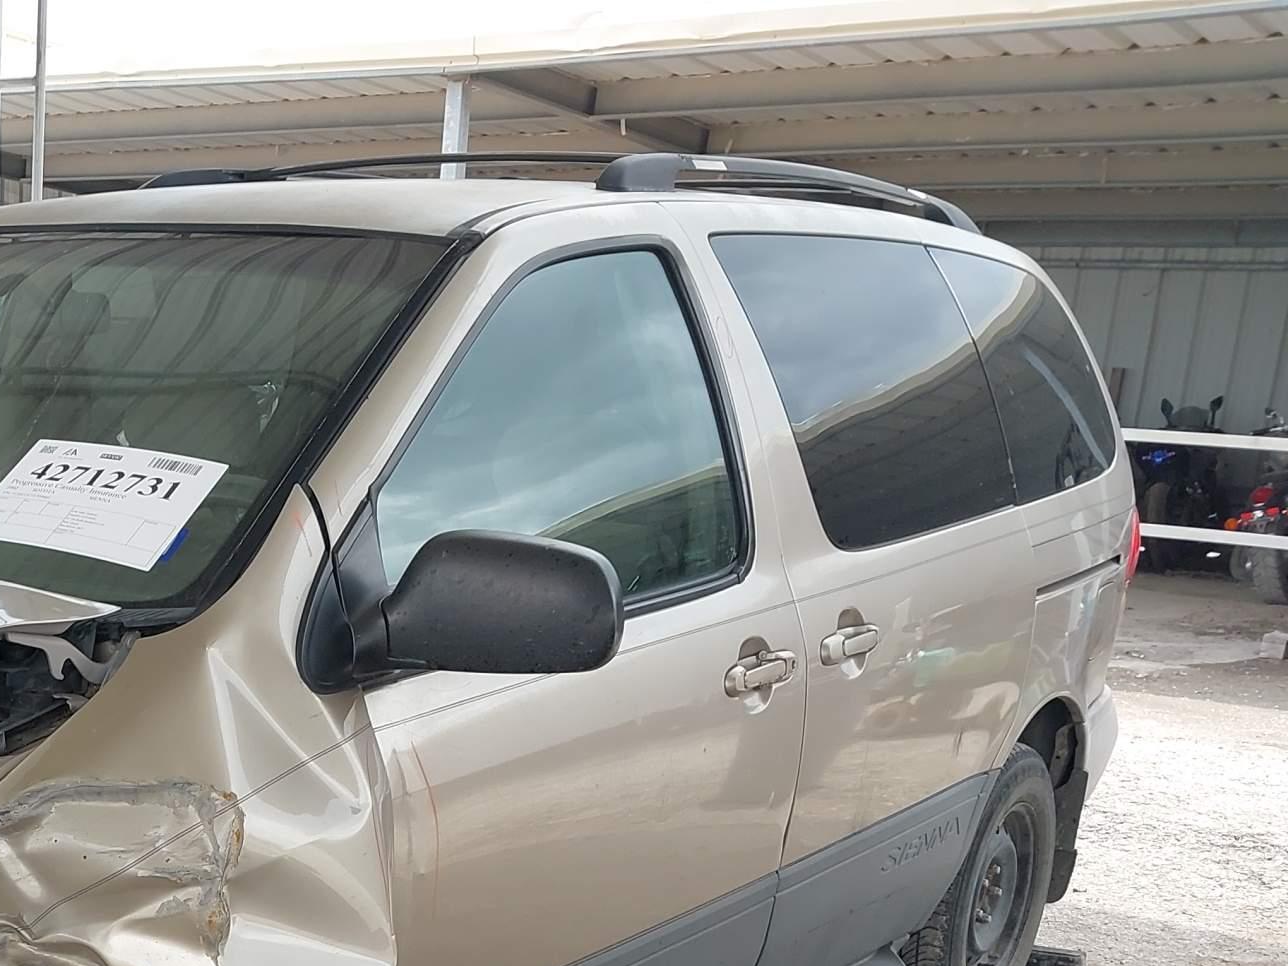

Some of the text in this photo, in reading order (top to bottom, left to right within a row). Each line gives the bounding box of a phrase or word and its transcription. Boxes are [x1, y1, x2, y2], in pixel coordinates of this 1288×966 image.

[11, 477, 54, 490] Progressive
[54, 483, 89, 495] Casualty
[89, 486, 127, 501] Insurance
[30, 461, 181, 502] 42712731
